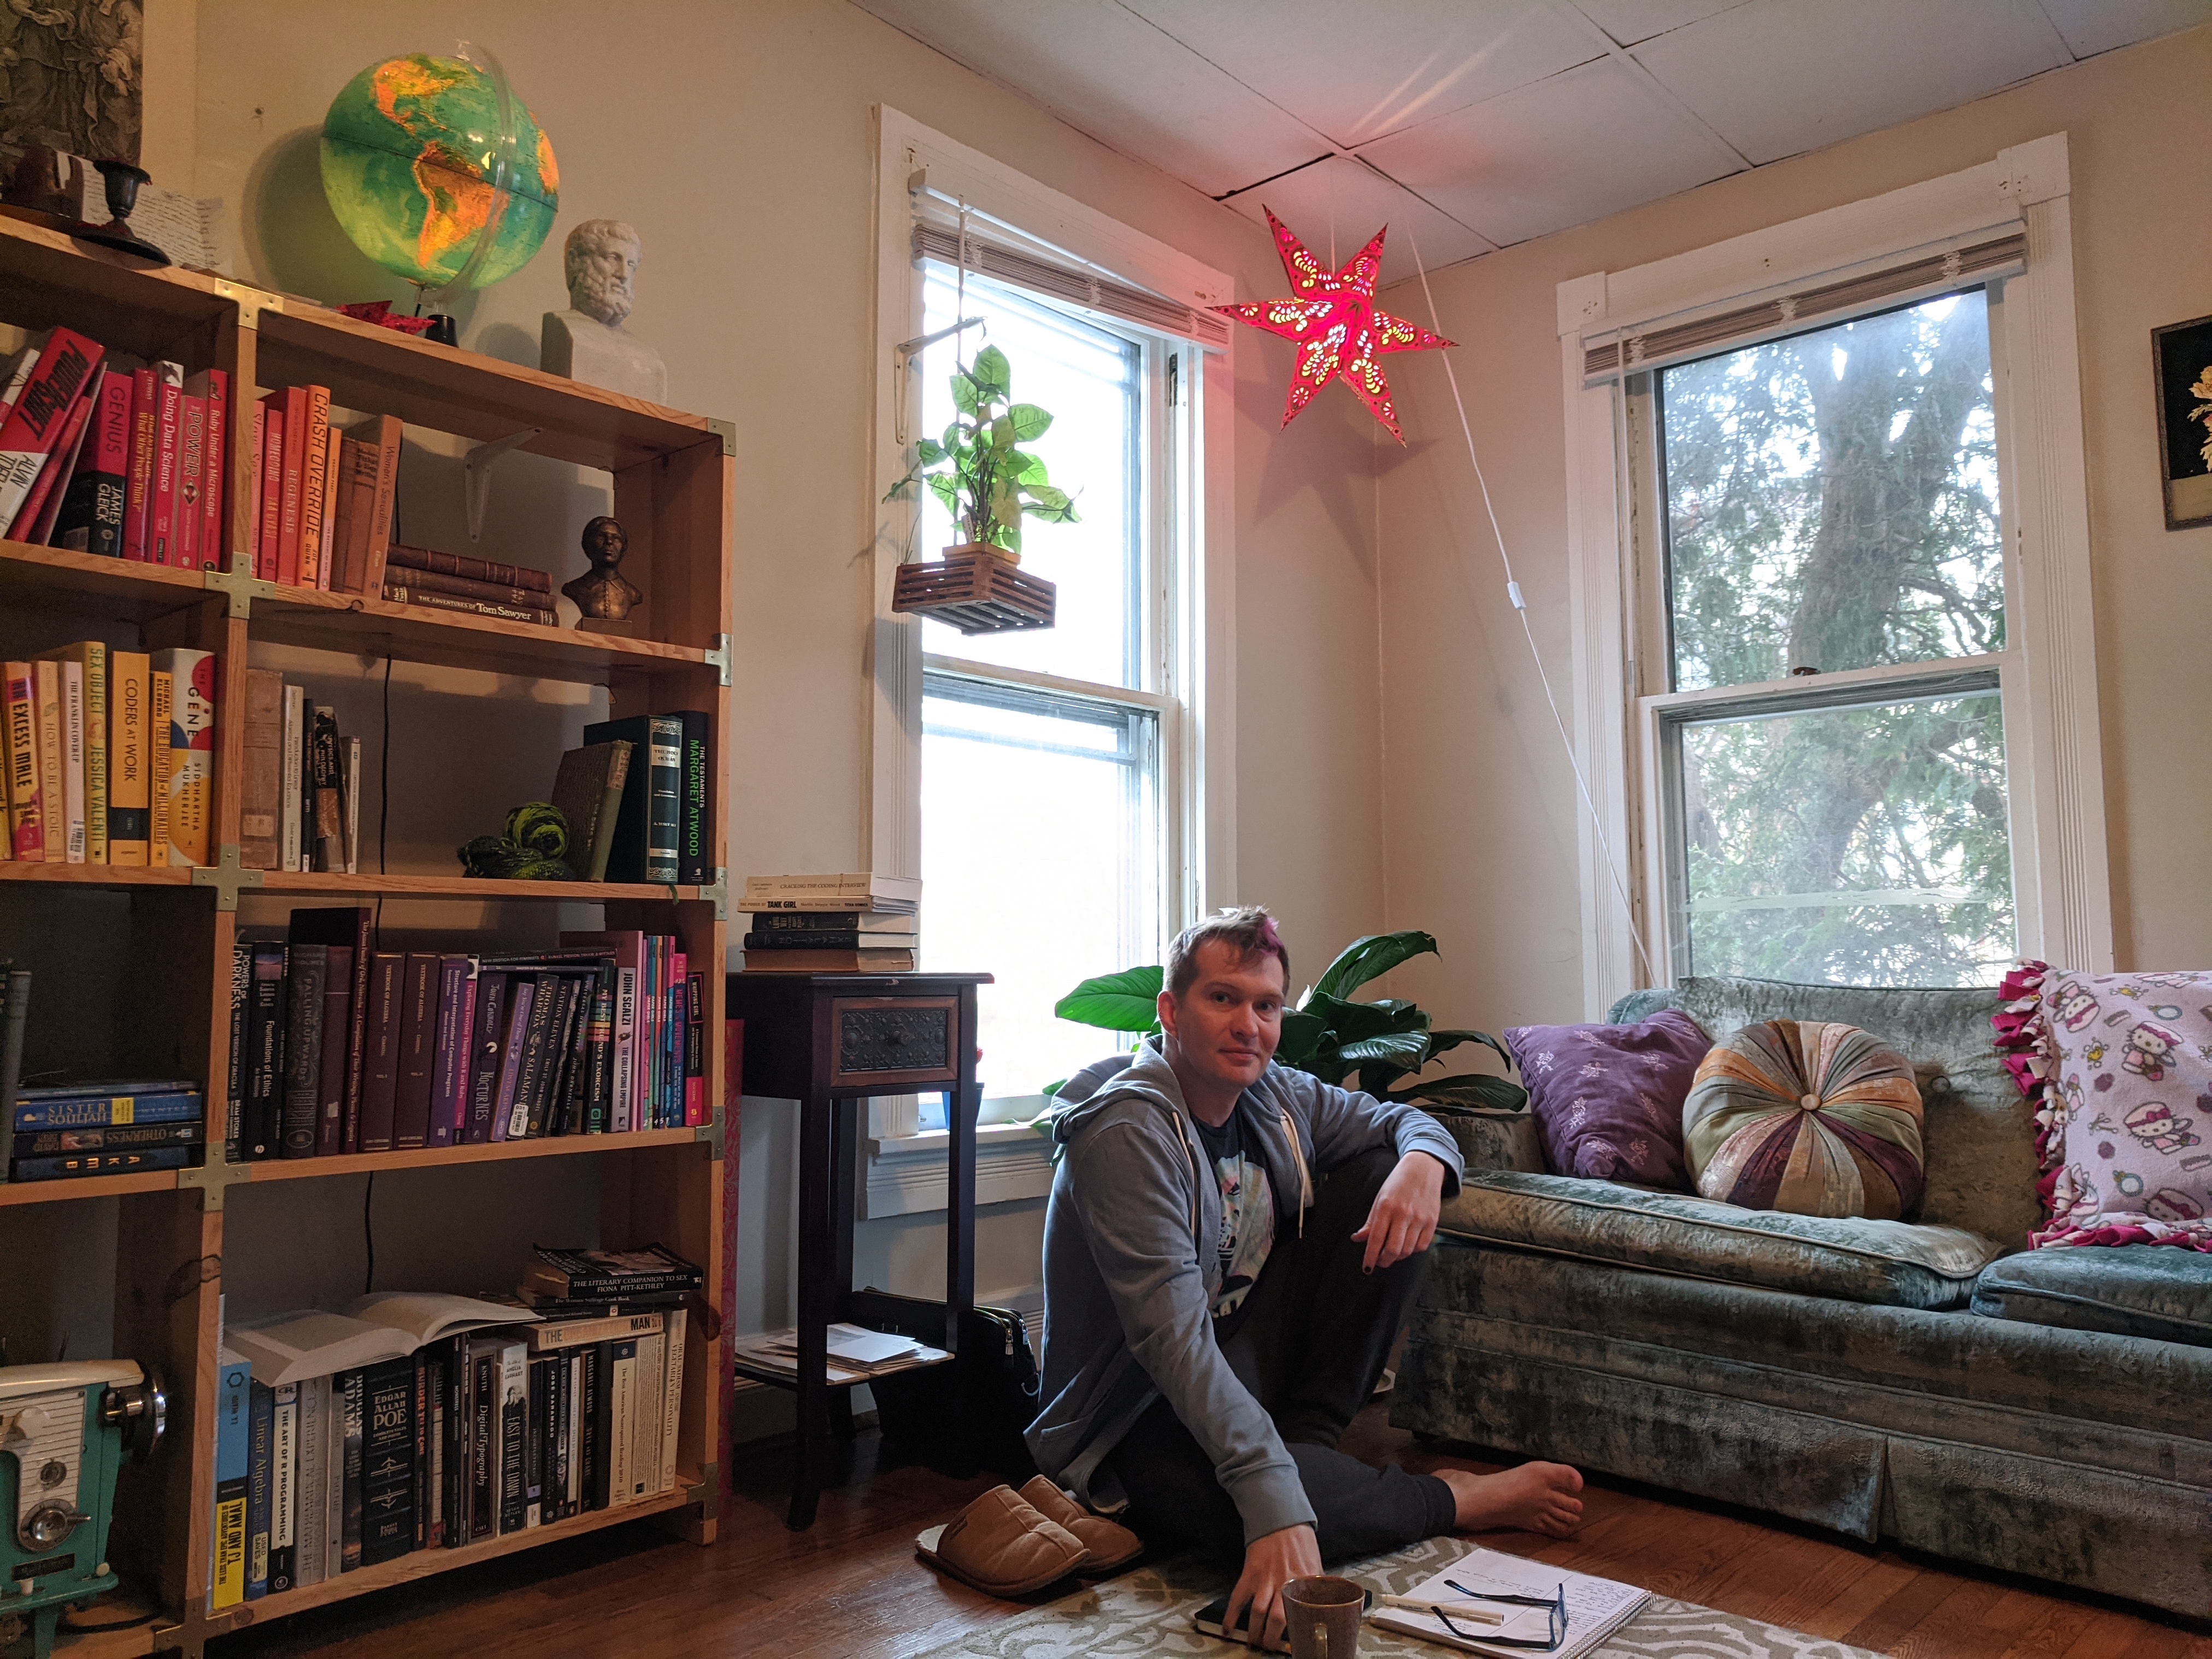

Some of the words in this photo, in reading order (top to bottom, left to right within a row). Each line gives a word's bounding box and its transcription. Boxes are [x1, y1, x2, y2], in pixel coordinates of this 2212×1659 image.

[106, 387, 126, 454] GENIUS
[163, 390, 178, 421] Doing
[209, 410, 221, 431] Ruby
[310, 393, 328, 449] CRASH
[163, 424, 175, 449] Data
[184, 413, 202, 478] POWER
[209, 433, 220, 459] Under
[10, 455, 37, 490] ALVIN
[160, 451, 174, 492] Science
[96, 484, 110, 522] GLEICK
[108, 486, 123, 525] JAMES
[205, 469, 218, 517] Microscope
[285, 469, 297, 533] REGENESIS
[305, 454, 324, 539] OVERRIDE
[476, 602, 497, 614] Tom
[498, 607, 532, 621] Sawyer
[91, 648, 103, 668] SEX
[90, 673, 104, 714] OBJECT
[125, 679, 139, 726] CODERS
[186, 687, 200, 737] GENE
[90, 745, 104, 791] JESSICA
[125, 745, 138, 781] WORK
[689, 739, 699, 803] MARGARET
[90, 796, 105, 841] VALENTI
[689, 807, 699, 856] ATWOOD
[230, 950, 243, 1009] DARKNESS
[241, 955, 250, 989] POWERS
[622, 973, 633, 995] JOHN
[532, 980, 548, 1028] WHARTON
[539, 985, 553, 1026] THOMAS
[555, 985, 567, 1018] STATION
[601, 989, 608, 1000] MY
[621, 996, 633, 1026] SCALZI
[263, 1020, 274, 1063] Foundations
[548, 1020, 560, 1049] ELEVEN
[263, 1064, 272, 1073] of
[446, 1047, 455, 1072] Computer
[620, 1057, 628, 1088] COLLAPSING
[262, 1074, 272, 1097] Ethics
[474, 1071, 495, 1121] NOCTURNES
[593, 1061, 602, 1102] EXORCISM
[589, 1278, 621, 1286] LITERARY
[623, 1276, 664, 1284] COMPANION
[620, 1283, 664, 1291] PITT-KETHLEY
[544, 1328, 563, 1343] THE
[631, 1317, 650, 1331] MAN
[480, 1364, 489, 1391] KNUTH
[344, 1378, 355, 1438] ADAMS
[373, 1409, 408, 1430] POE
[478, 1404, 488, 1436] Digital
[255, 1416, 268, 1454] Linear
[507, 1416, 520, 1438] EAST
[281, 1448, 288, 1460] OF
[476, 1436, 488, 1486] Typography
[507, 1440, 520, 1451] TO
[507, 1454, 519, 1470] THE
[252, 1459, 267, 1504] Algebra
[506, 1472, 519, 1498] DAWN
[229, 1501, 243, 1529] AMAL
[279, 1471, 287, 1540] PROGRAMMING
[228, 1531, 242, 1550] AND
[227, 1551, 241, 1565] TJ
